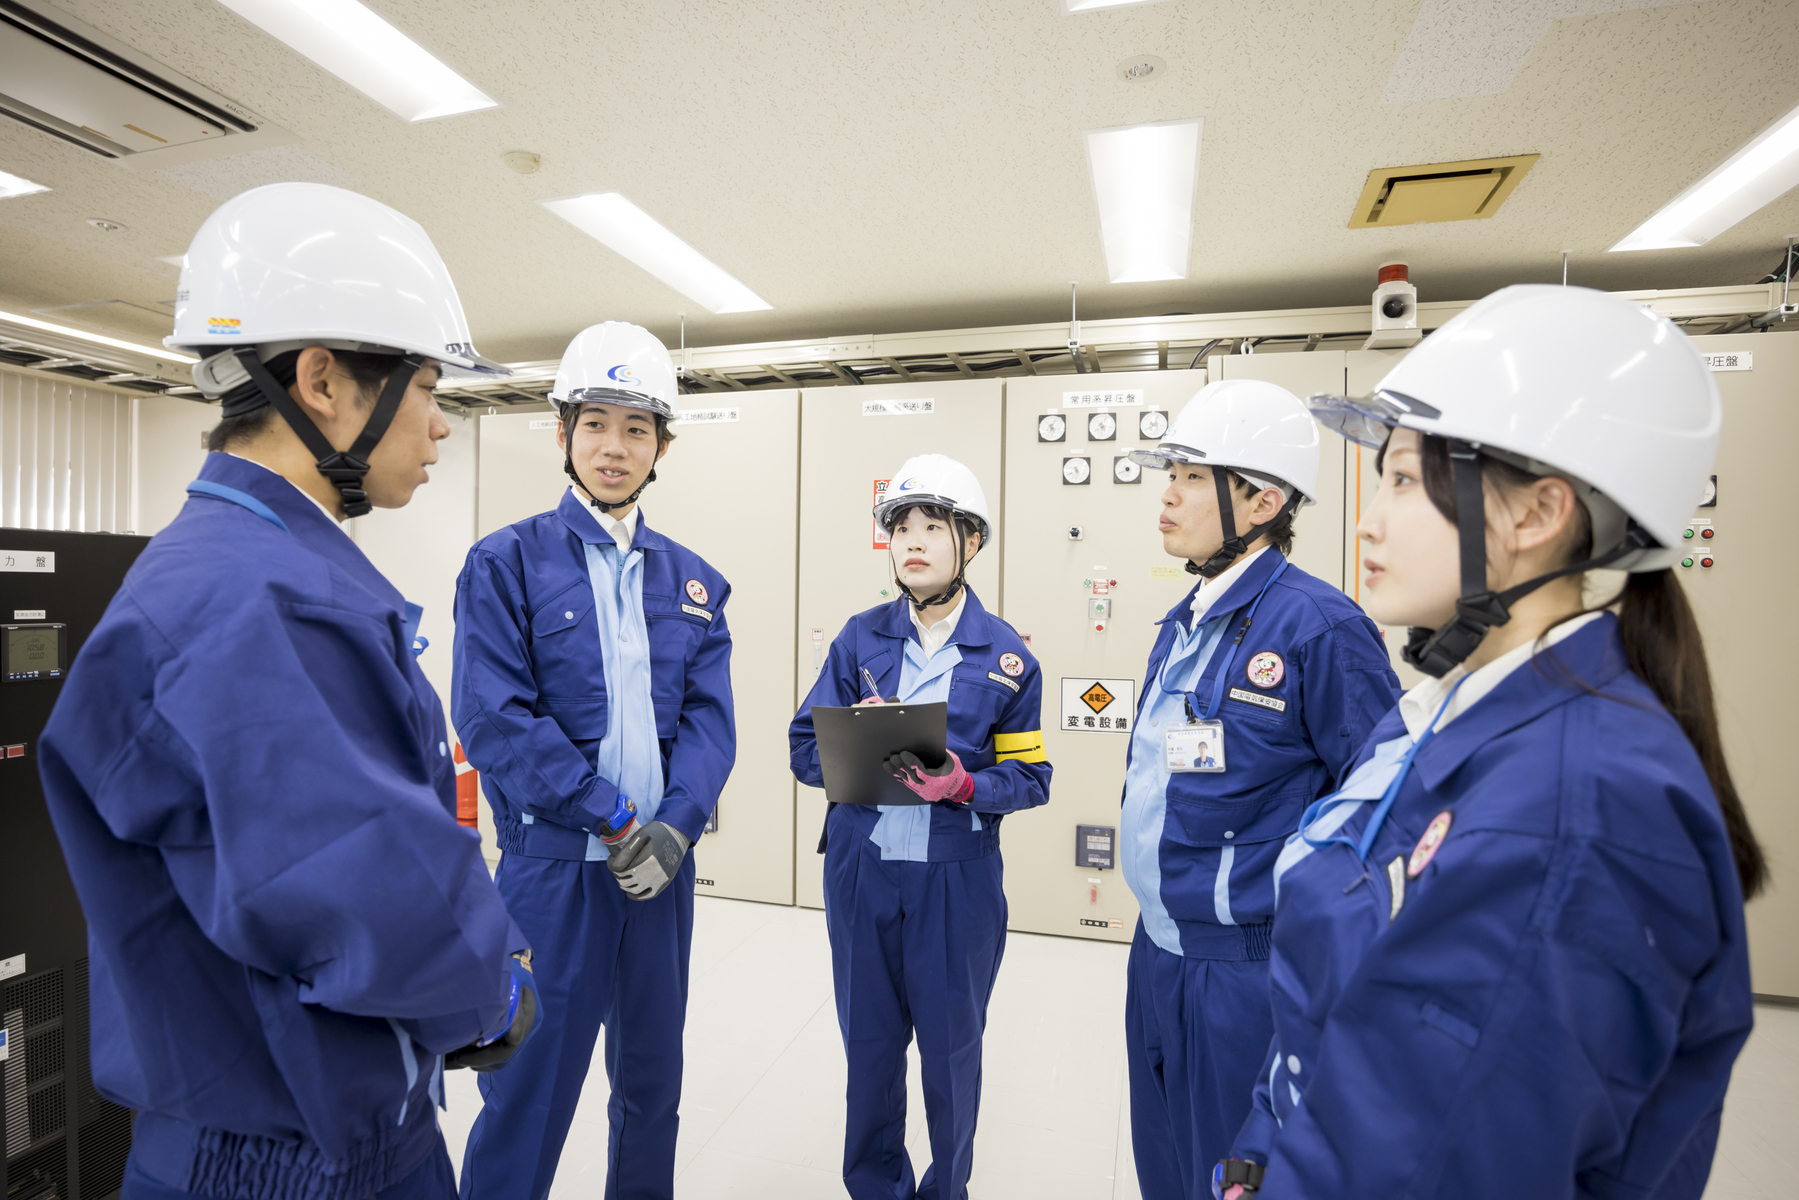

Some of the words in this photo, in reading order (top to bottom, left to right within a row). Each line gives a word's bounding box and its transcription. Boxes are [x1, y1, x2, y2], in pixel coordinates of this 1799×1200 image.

[1070, 394, 1136, 404] 常用系昇圧盤
[1088, 693, 1107, 702] 高電圧
[1067, 715, 1128, 729] 変電設備
